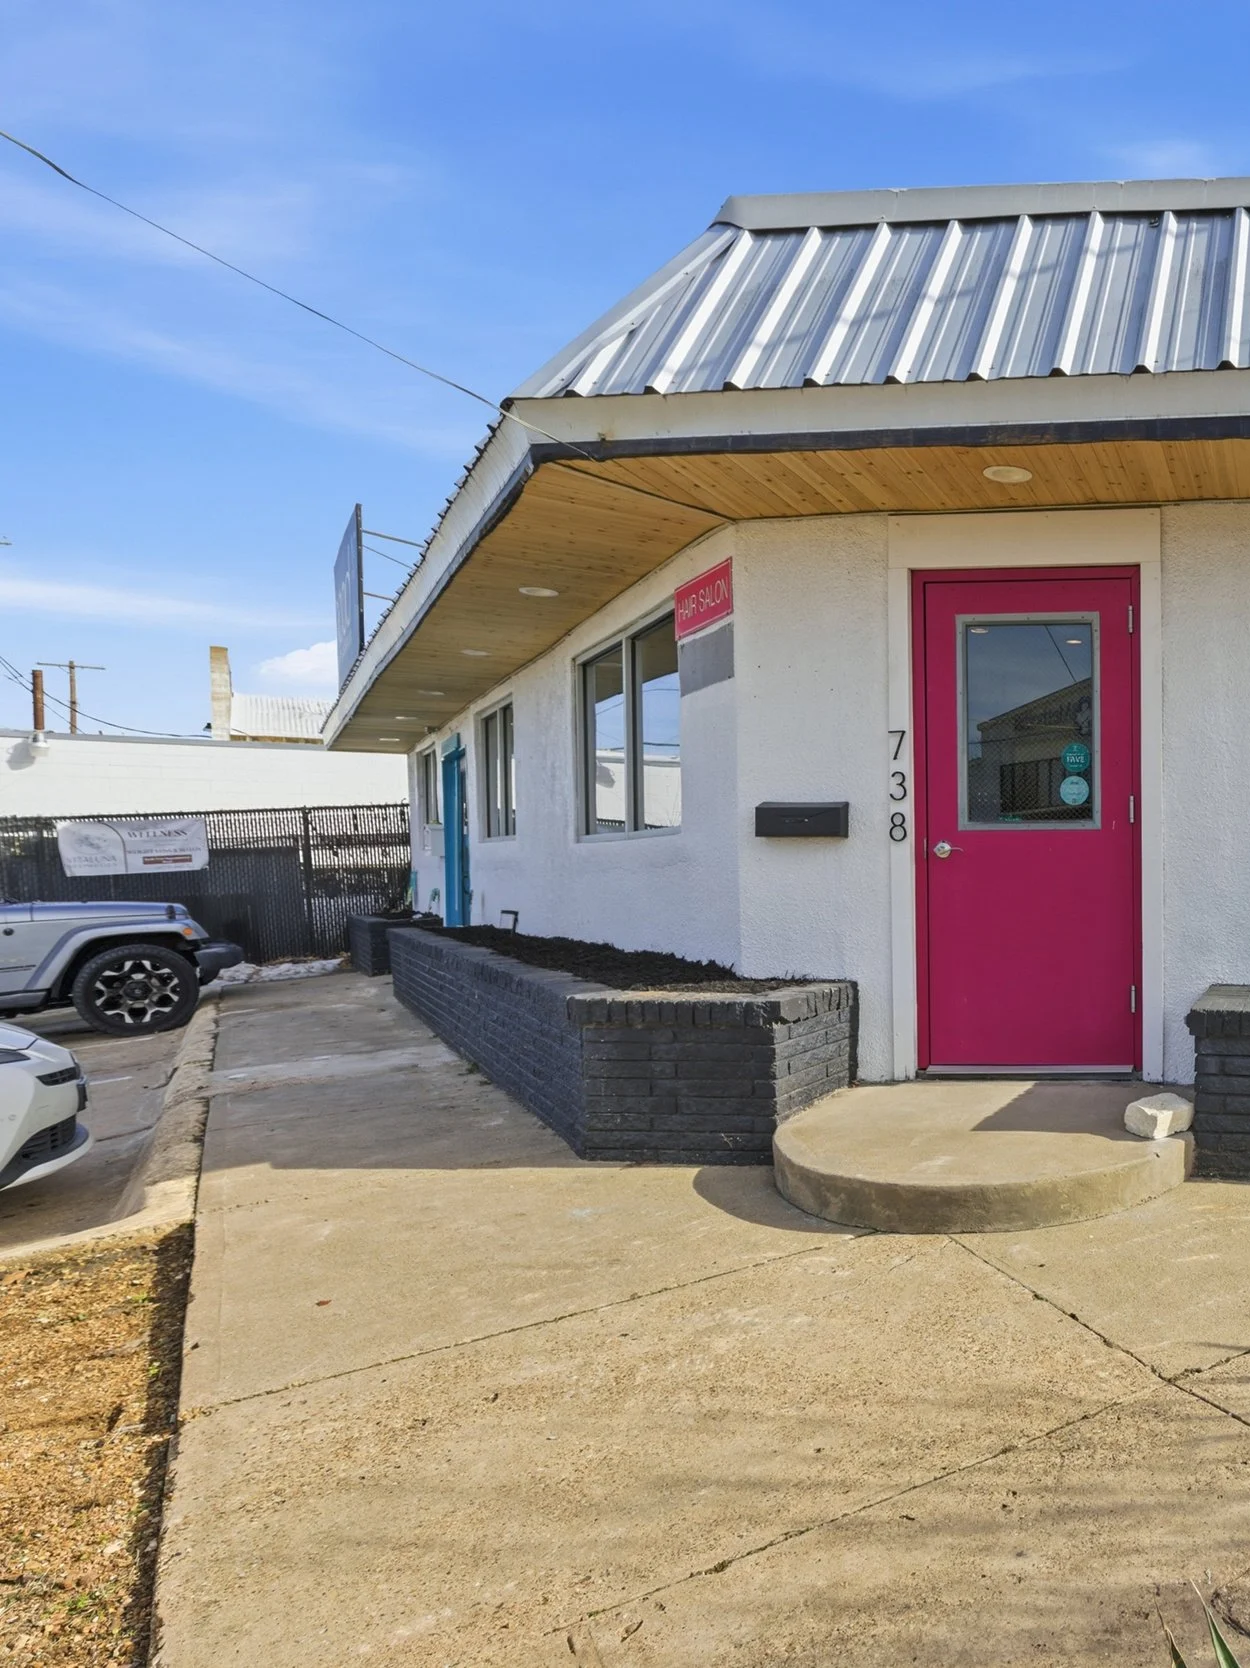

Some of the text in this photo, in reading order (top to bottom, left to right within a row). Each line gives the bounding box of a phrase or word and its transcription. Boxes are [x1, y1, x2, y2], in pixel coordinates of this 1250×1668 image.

[678, 578, 729, 623] HAIR SALON
[888, 730, 907, 842] 738
[127, 829, 188, 839] WELLNESS
